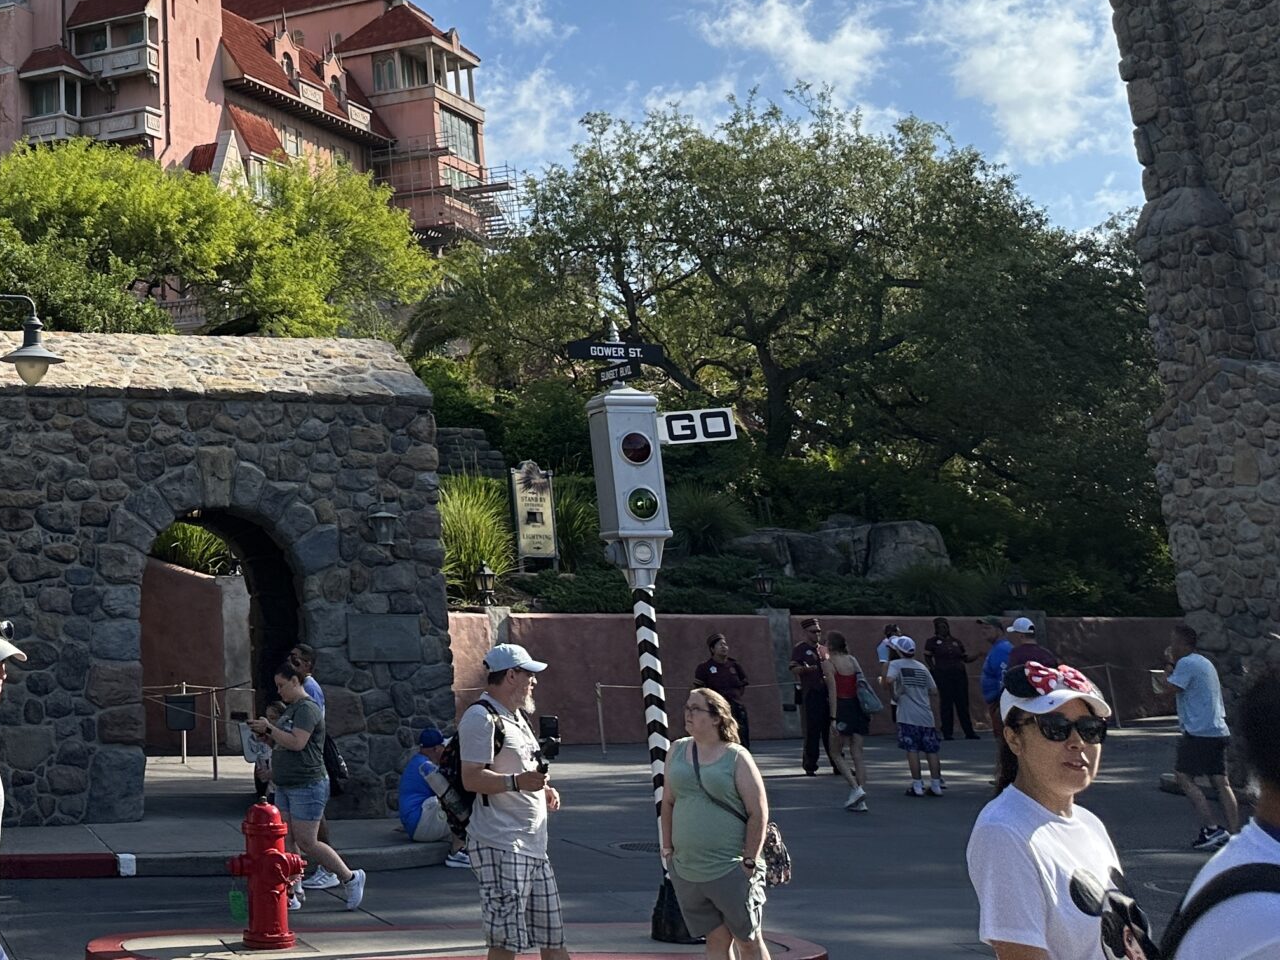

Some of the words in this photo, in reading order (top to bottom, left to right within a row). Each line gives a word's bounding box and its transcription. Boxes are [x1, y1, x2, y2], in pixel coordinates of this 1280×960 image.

[590, 346, 625, 357] GOWER
[628, 348, 643, 358] ST.
[600, 368, 619, 382] SUNSET
[665, 411, 731, 441] GO
